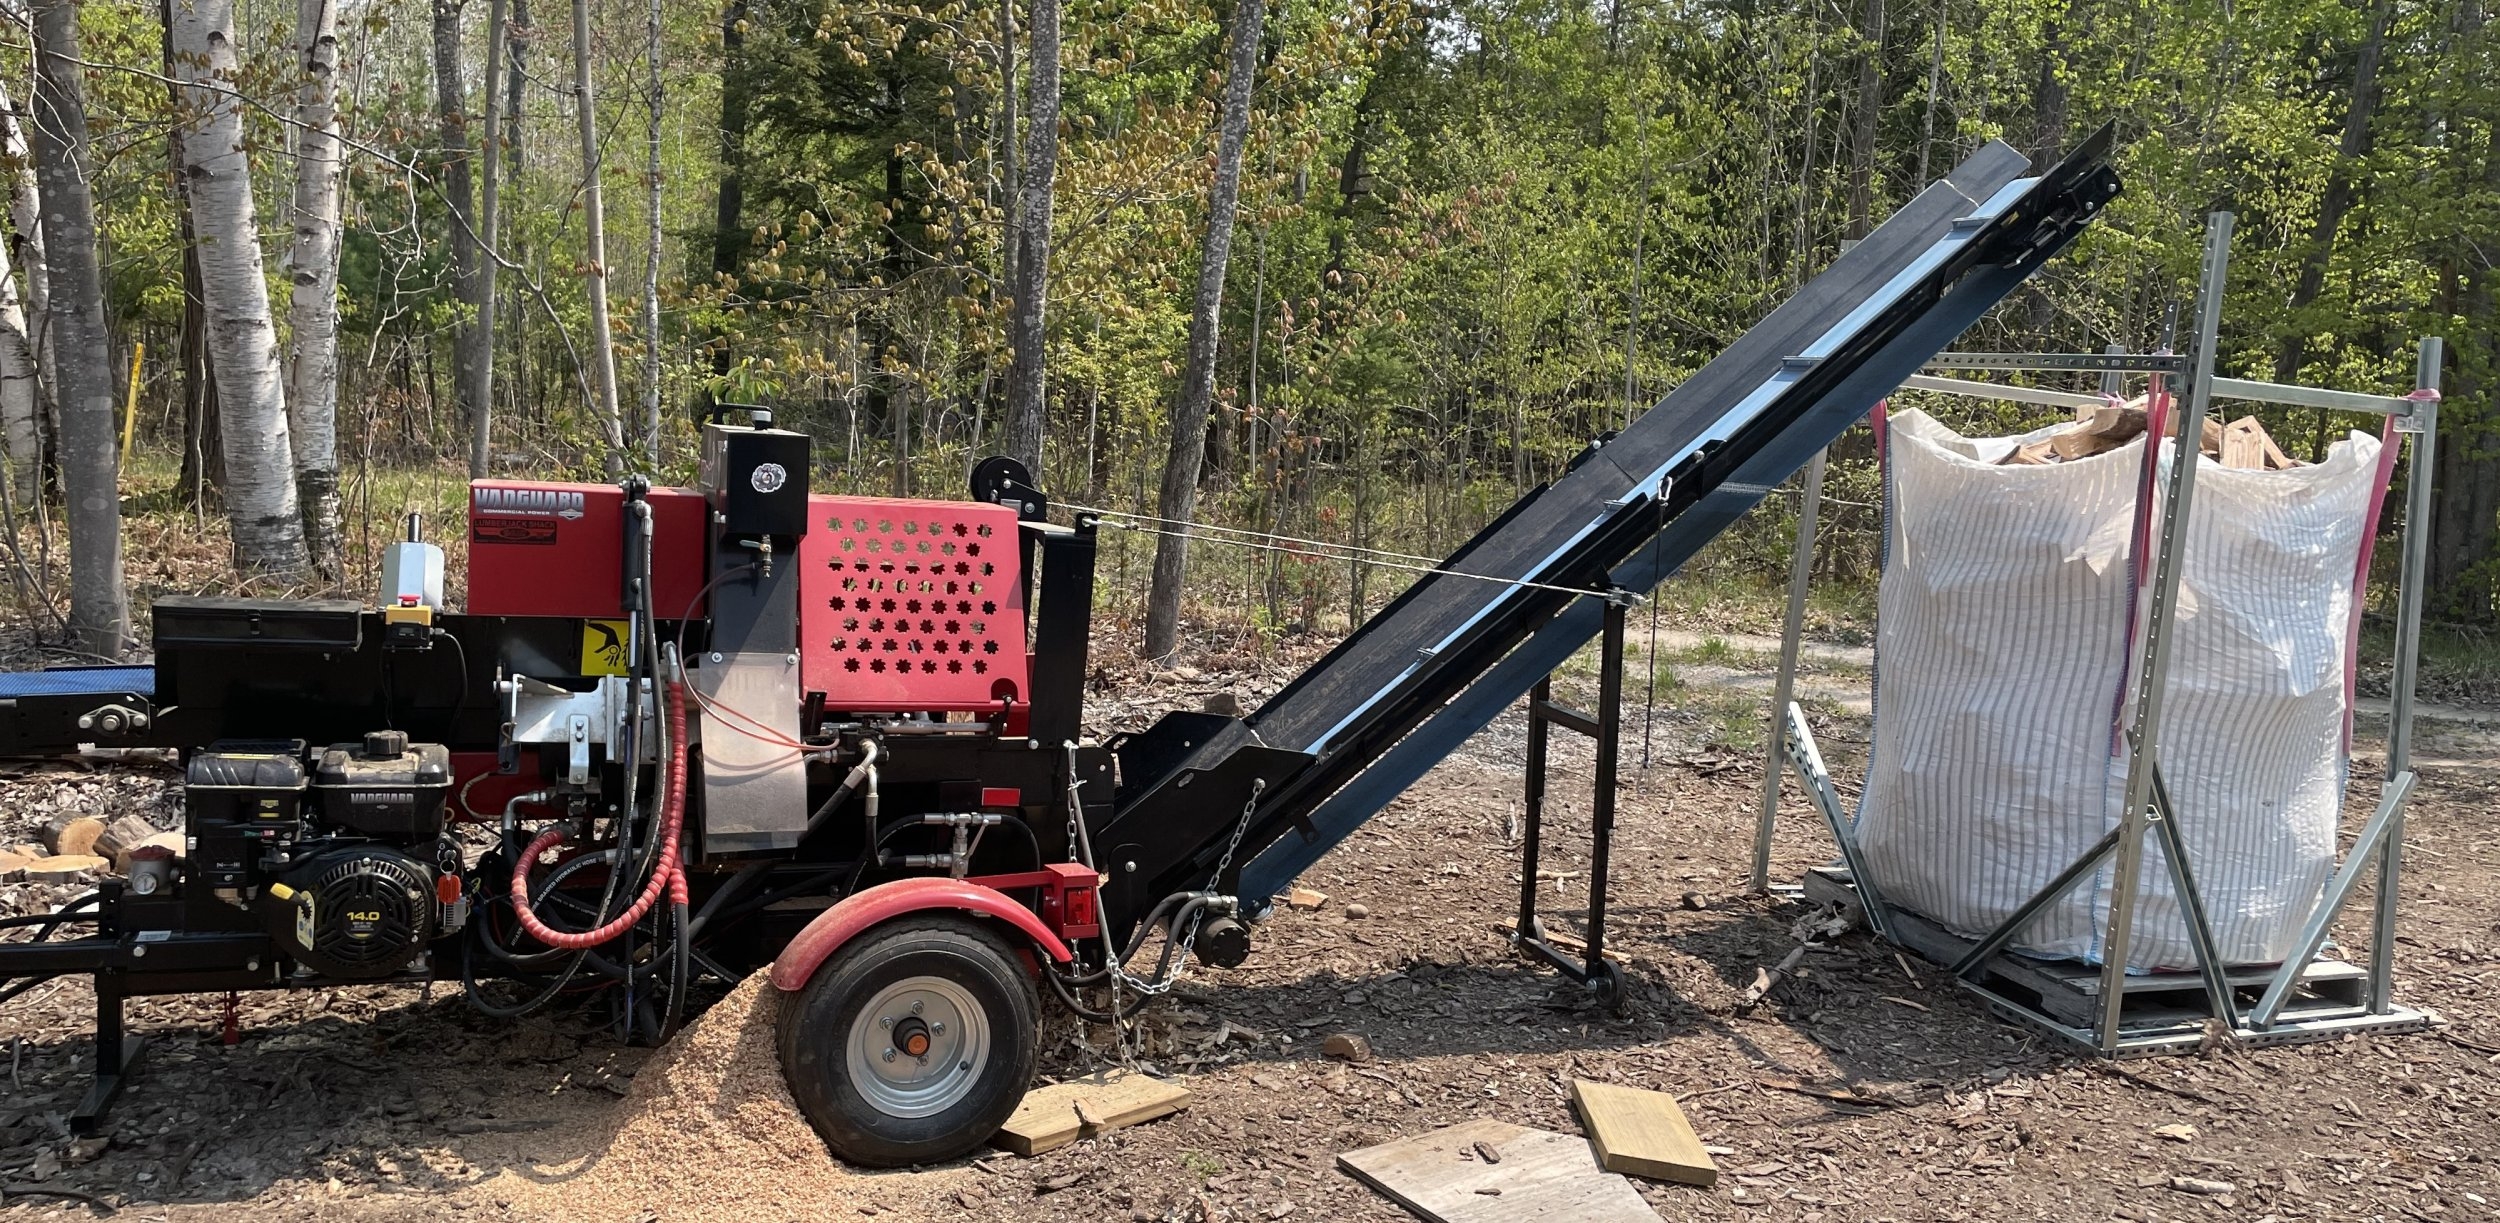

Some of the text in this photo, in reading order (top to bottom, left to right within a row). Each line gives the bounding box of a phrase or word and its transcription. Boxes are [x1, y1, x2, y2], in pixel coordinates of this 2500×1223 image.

[474, 488, 584, 511] VANGUARD
[474, 519, 555, 529] LUMBERJACK SHACK
[351, 793, 414, 804] VANGUARD
[555, 862, 582, 884] HYDRAULIC
[346, 911, 380, 921] 14.0
